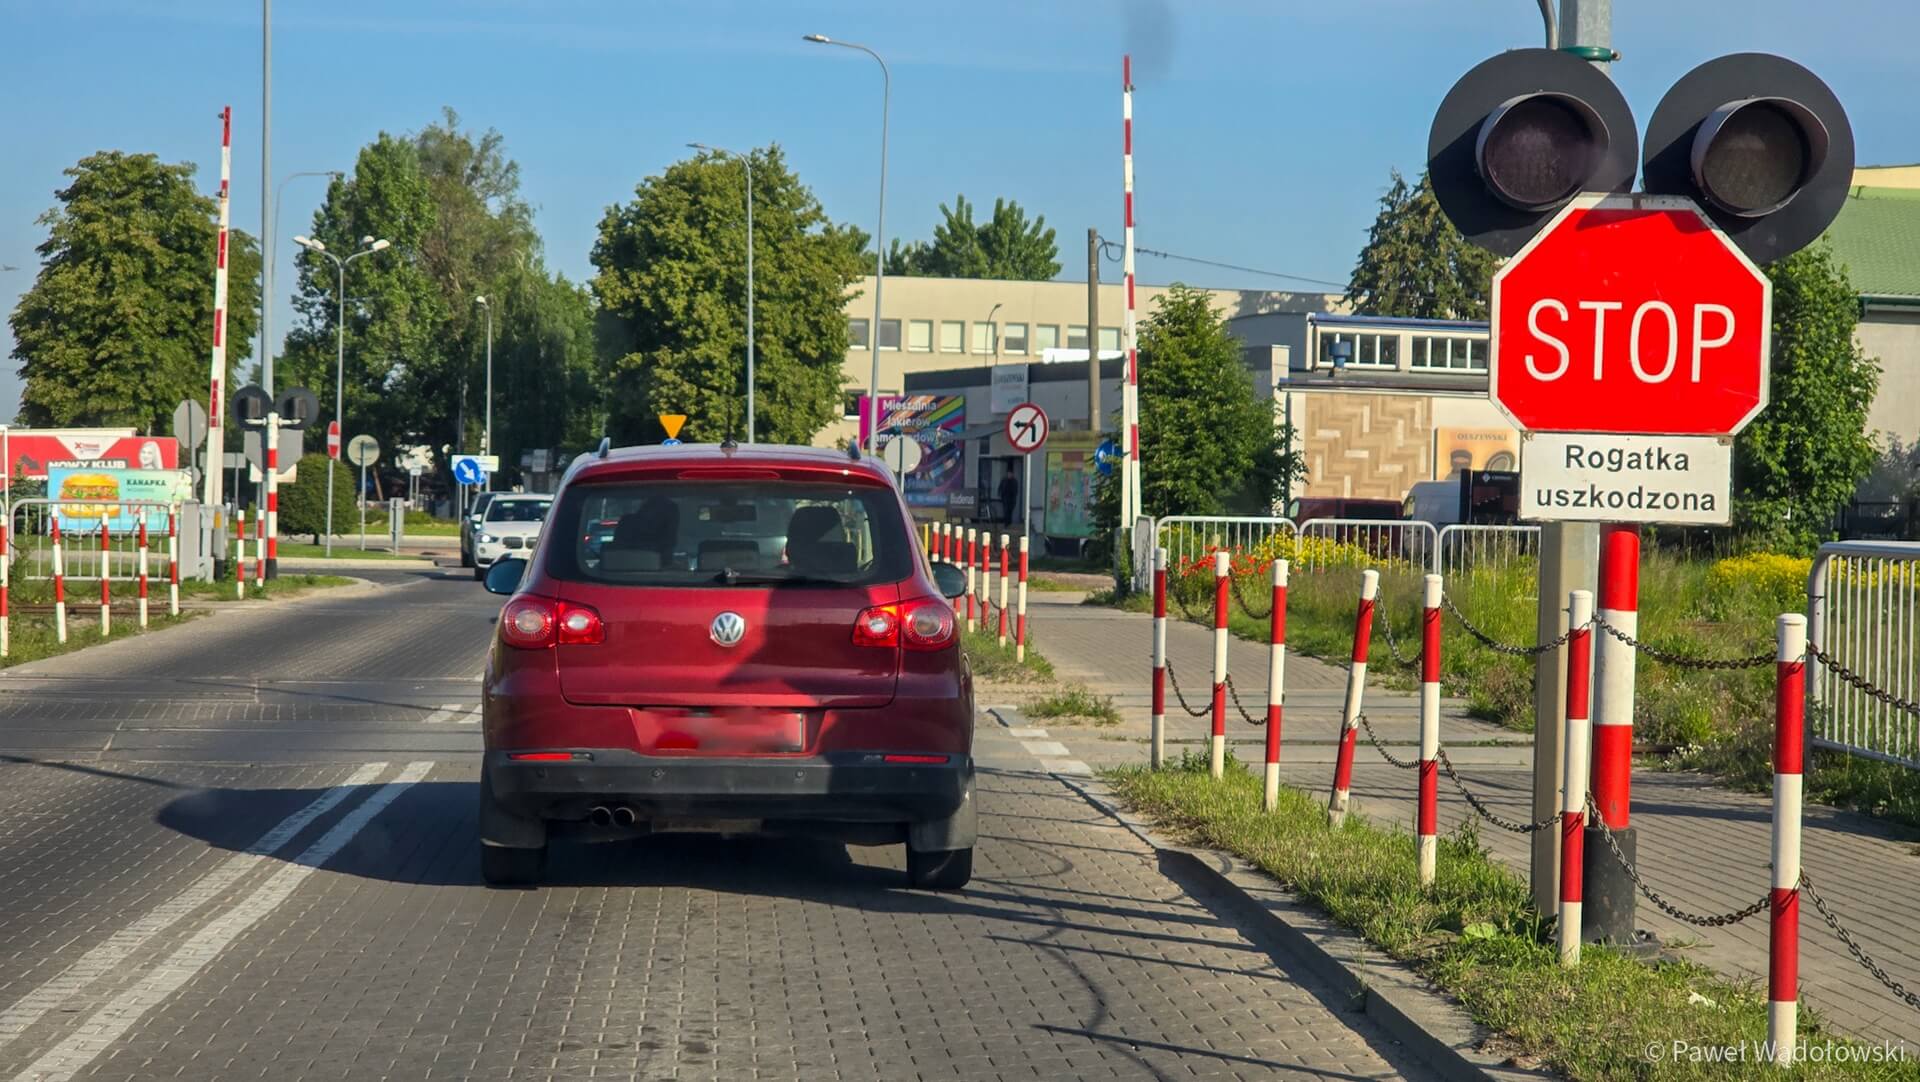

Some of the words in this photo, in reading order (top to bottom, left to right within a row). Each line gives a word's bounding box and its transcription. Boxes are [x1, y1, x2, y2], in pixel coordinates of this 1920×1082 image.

[1524, 298, 1736, 383] STOP
[1565, 444, 1689, 472] Rogatka
[1536, 484, 1716, 511] uszkodzona
